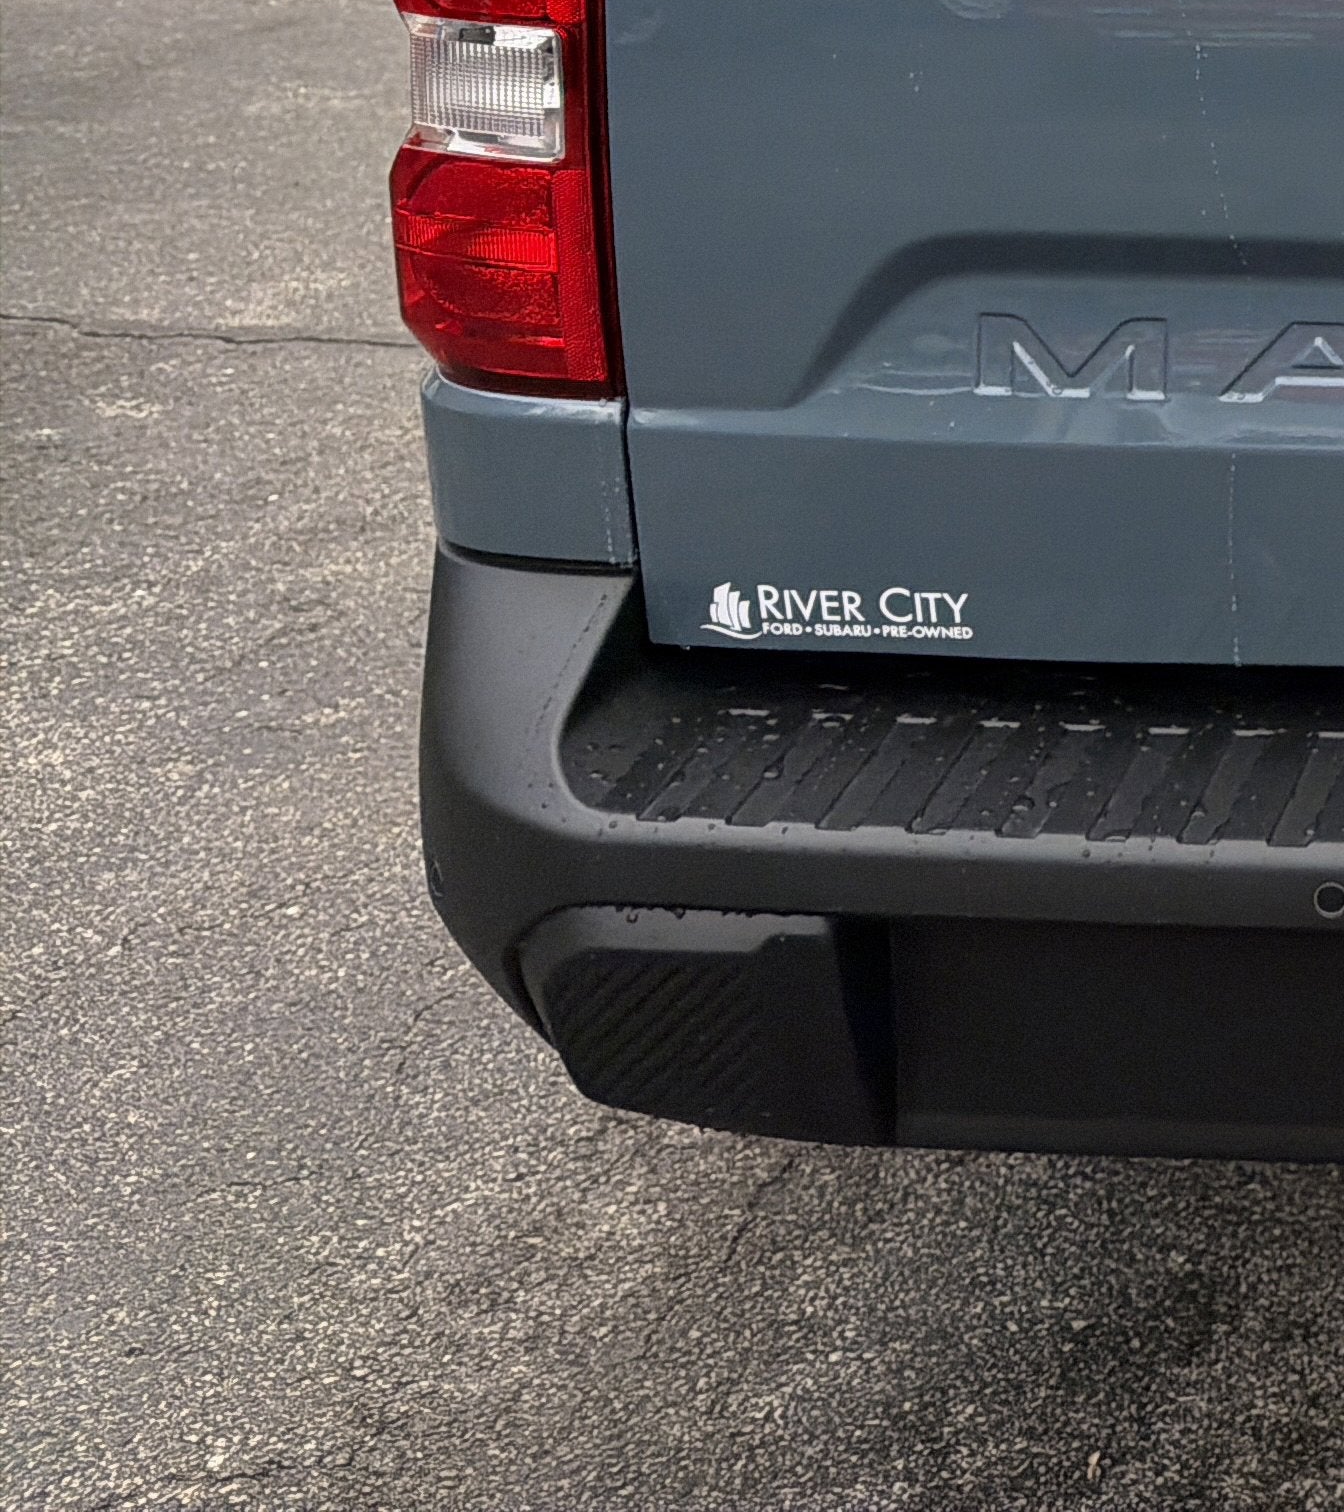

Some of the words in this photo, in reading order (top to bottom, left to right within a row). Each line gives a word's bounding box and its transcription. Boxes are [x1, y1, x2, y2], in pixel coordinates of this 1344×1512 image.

[757, 584, 865, 621] RIVER
[879, 587, 968, 623] CITY
[762, 622, 802, 636] FORD
[814, 624, 871, 637] SUBARU
[882, 625, 973, 639] PRE-OWNED
